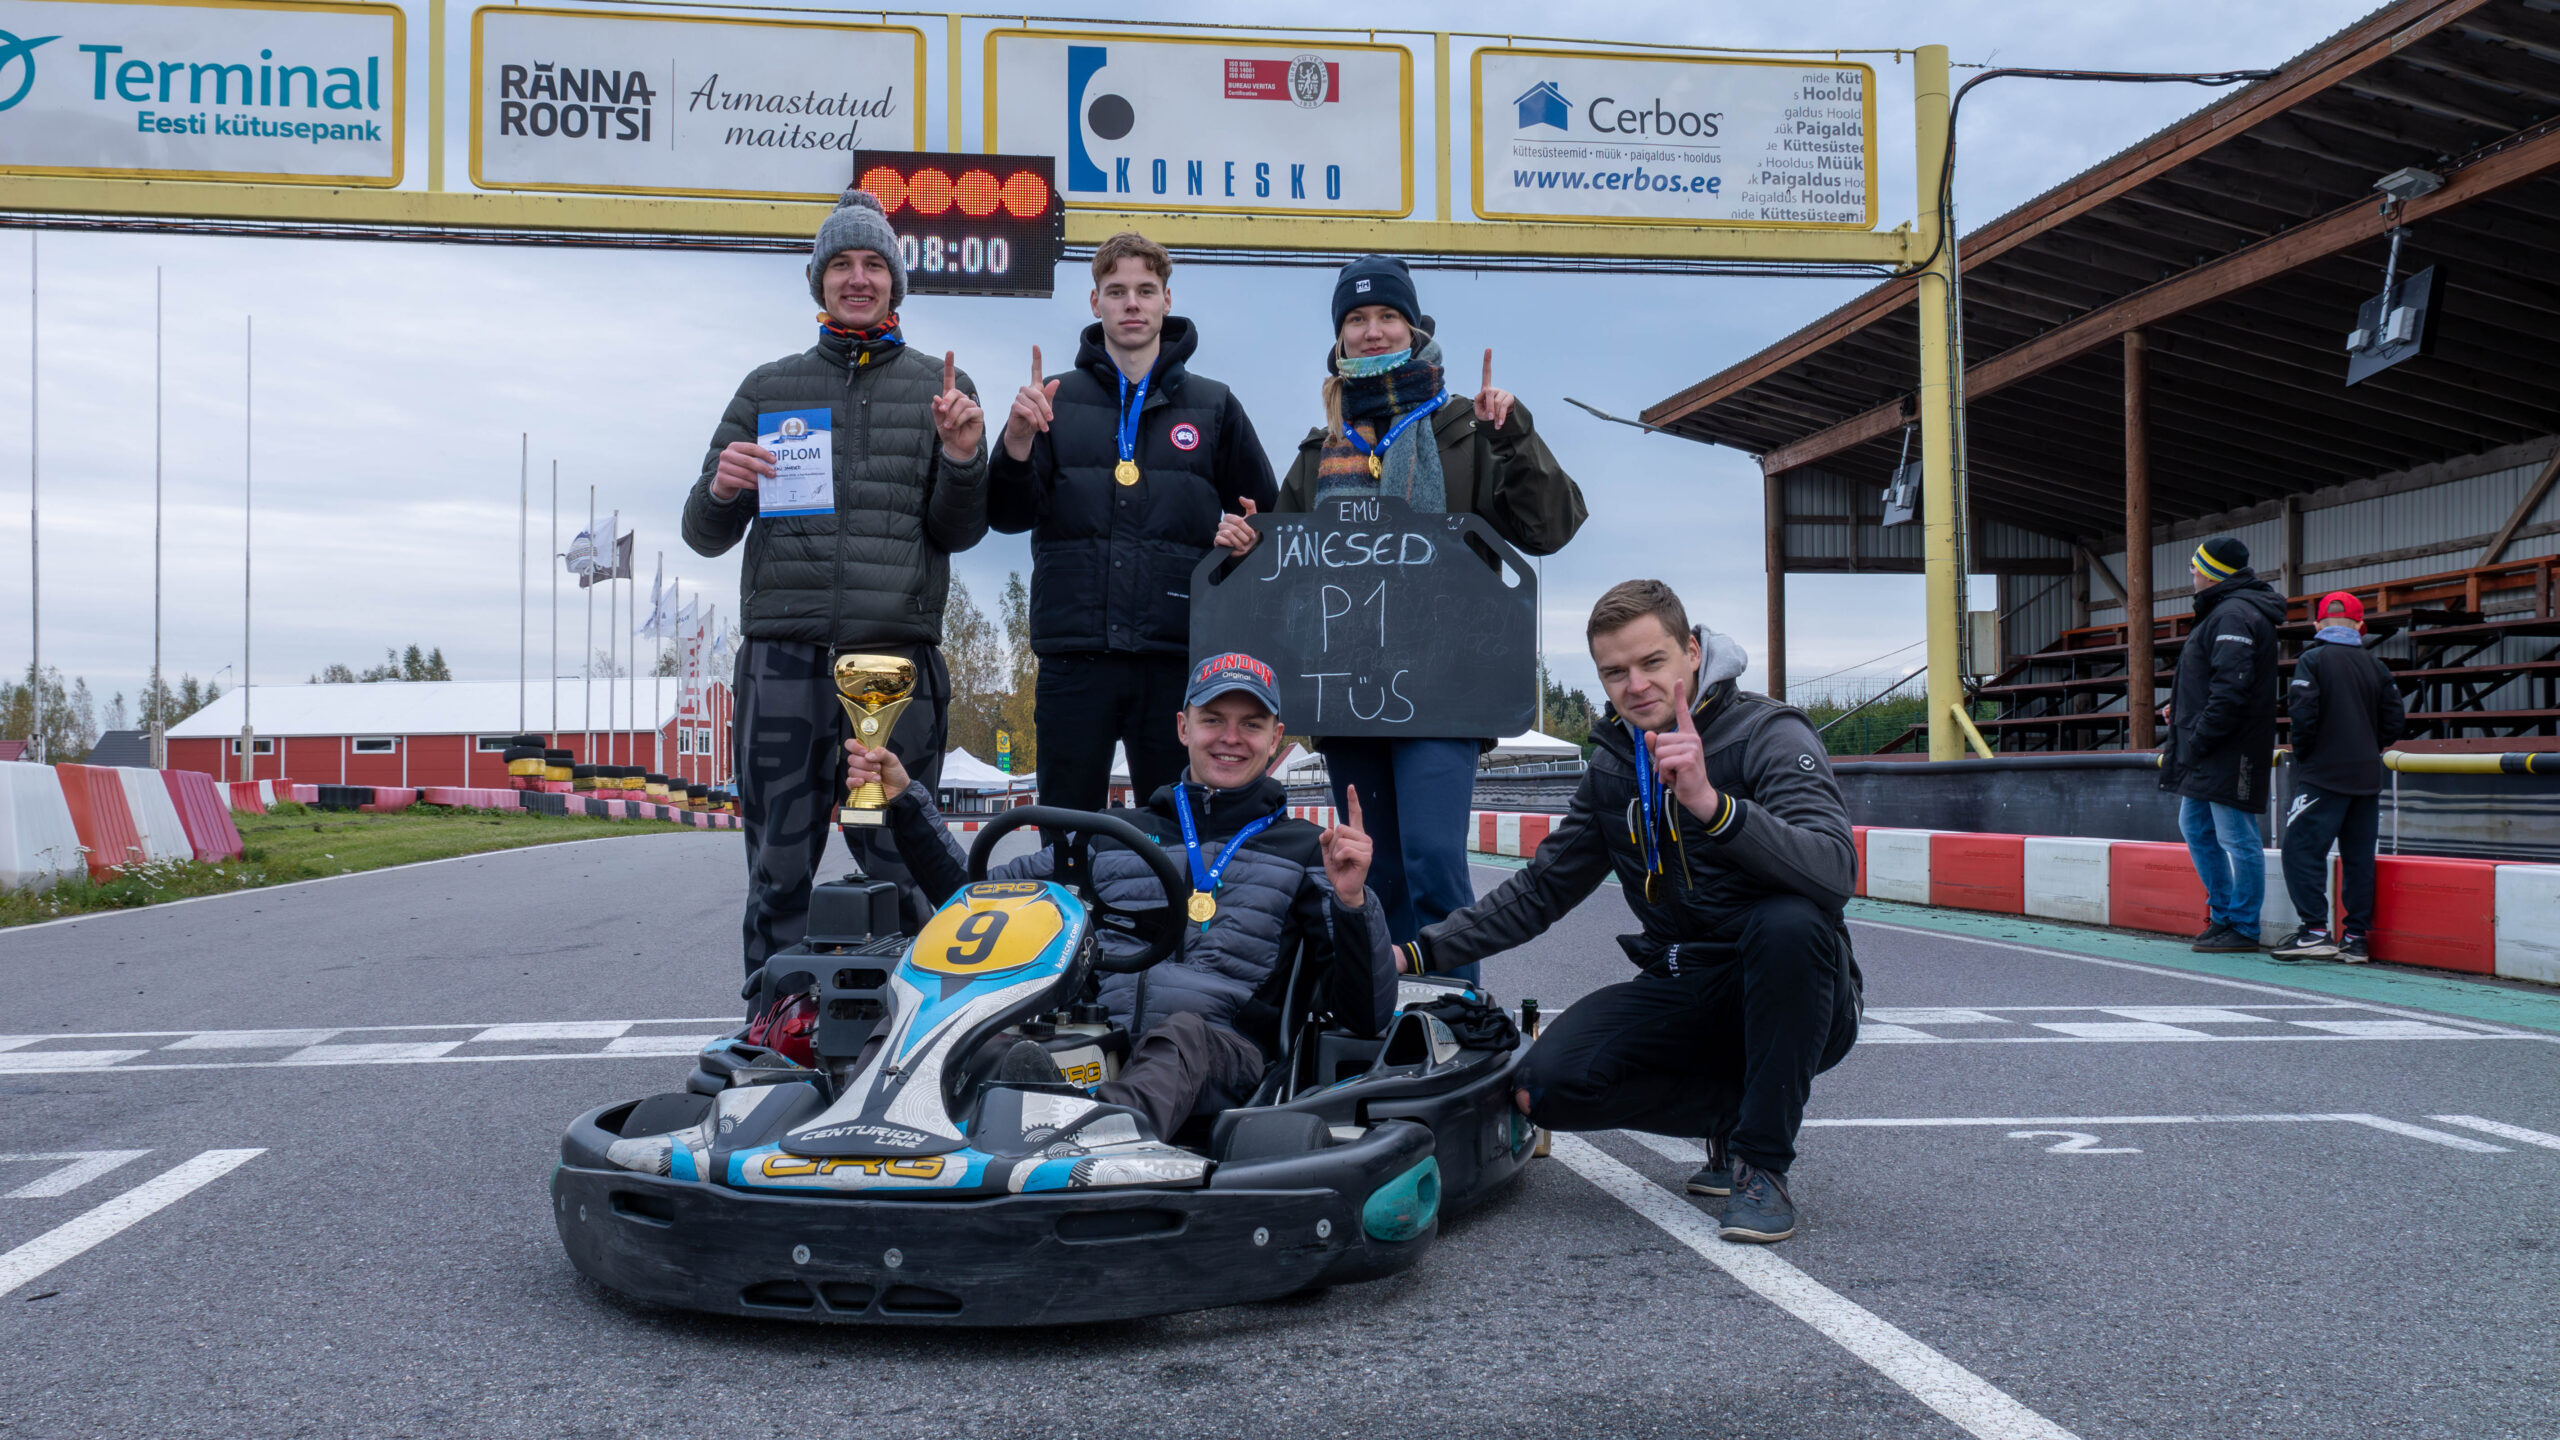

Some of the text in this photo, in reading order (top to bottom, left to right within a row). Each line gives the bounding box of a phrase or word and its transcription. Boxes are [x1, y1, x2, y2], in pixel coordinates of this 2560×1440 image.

[79, 44, 381, 111] Terminal
[500, 60, 656, 106] RÄNNA
[688, 73, 897, 118] Armastatud
[138, 111, 382, 144] Eesti kütusepank
[500, 102, 651, 142] ROOTSI
[1588, 97, 1720, 138] Cerbos
[724, 120, 863, 151] maitsed
[1513, 145, 1722, 164] küttesüsteemid müük paigaldus hooldus
[1766, 157, 1814, 169] Hooldus
[1817, 156, 1864, 171] Müük
[1116, 157, 1341, 200] KONESKO
[1513, 167, 1722, 194] www.cerbos.ee
[1761, 171, 1842, 189] Paigaldus
[1760, 207, 1866, 222] Küttesüsteemi
[1339, 497, 1380, 522] EMÜ
[1201, 653, 1273, 688] LONDON
[1222, 671, 1251, 681] Original
[1300, 670, 1415, 723] TÜS
[972, 882, 1038, 895] CRG
[946, 910, 1010, 965] 9
[1054, 923, 1081, 969] kartcrg.com
[1059, 1062, 1101, 1085] RG
[800, 1125, 929, 1143] CENTURION
[874, 1137, 922, 1149] LINE
[2007, 1130, 2144, 1154] 2
